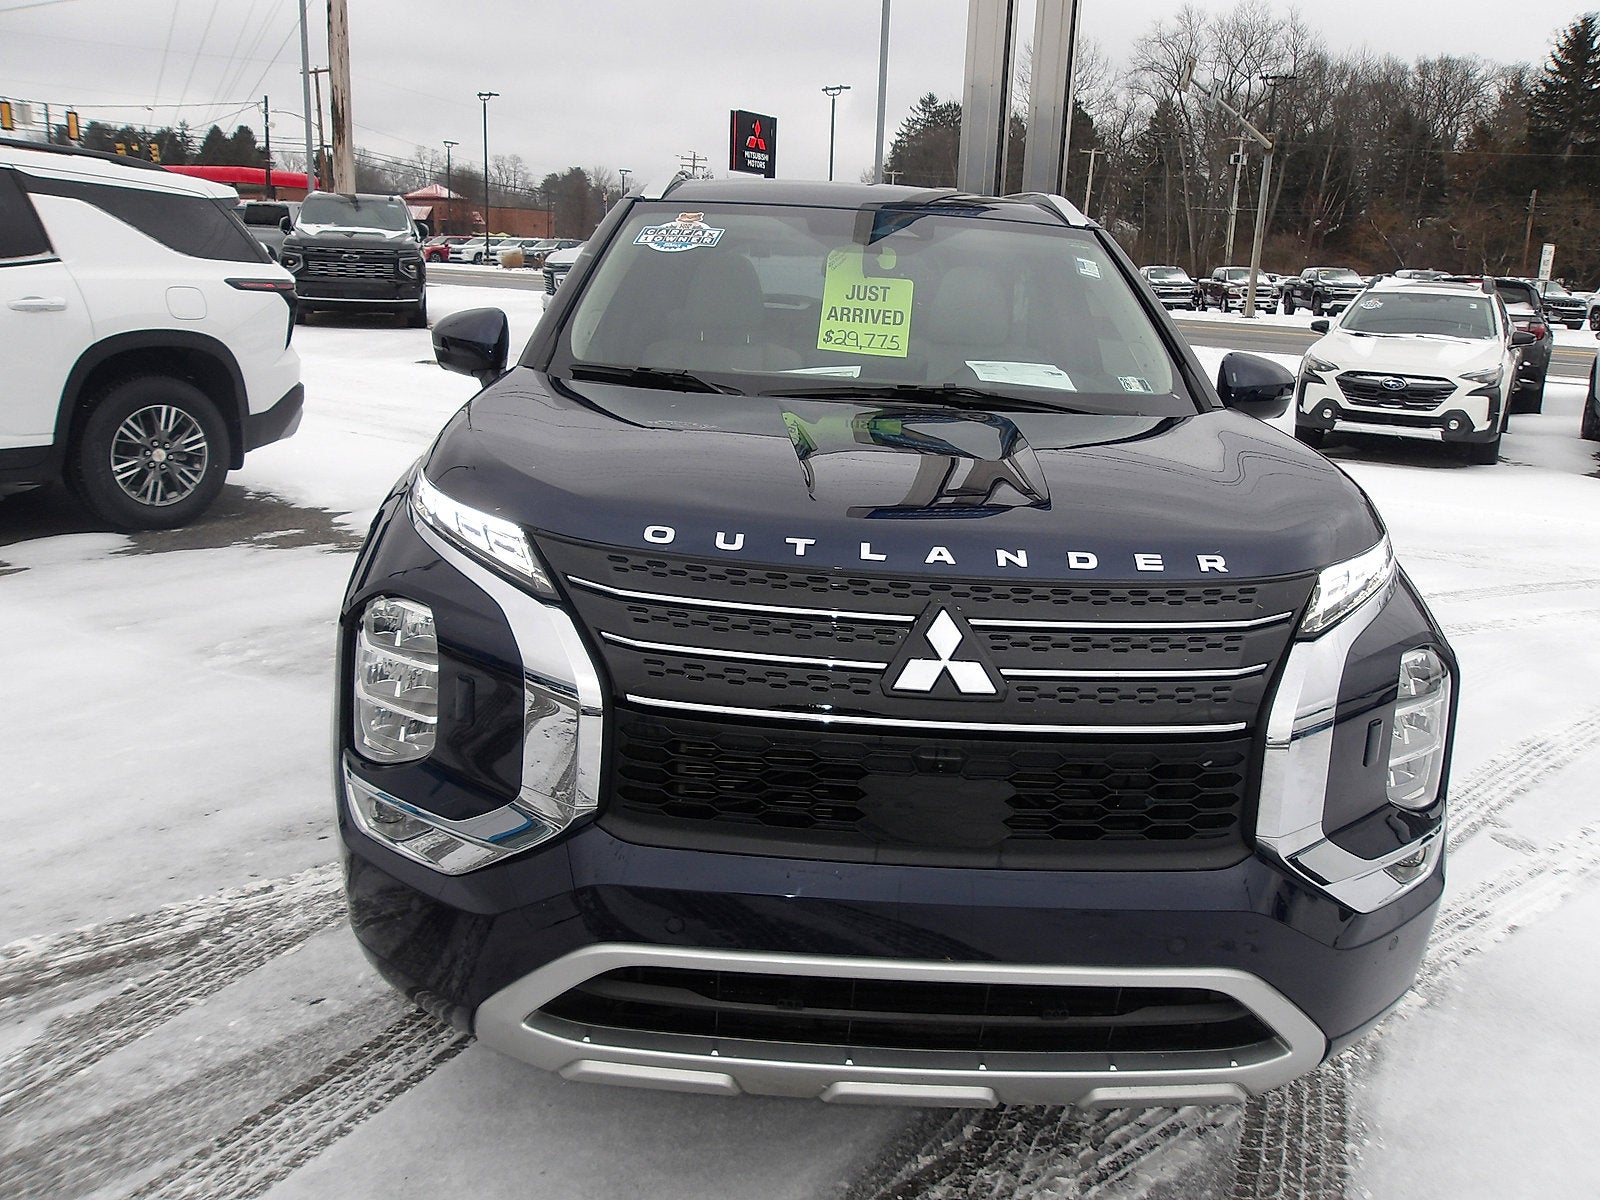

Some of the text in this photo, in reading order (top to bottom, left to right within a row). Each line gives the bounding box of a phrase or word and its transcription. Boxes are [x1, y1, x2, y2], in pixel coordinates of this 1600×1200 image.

[744, 151, 769, 161] MITSUBISHI
[747, 159, 766, 169] MOTORS
[645, 229, 716, 238] CARFAX
[653, 235, 715, 244] OWNER
[845, 284, 891, 302] JUST
[826, 306, 905, 326] ARRIVED
[822, 329, 901, 351] $29,775
[643, 525, 1229, 573] OUTLANDER
